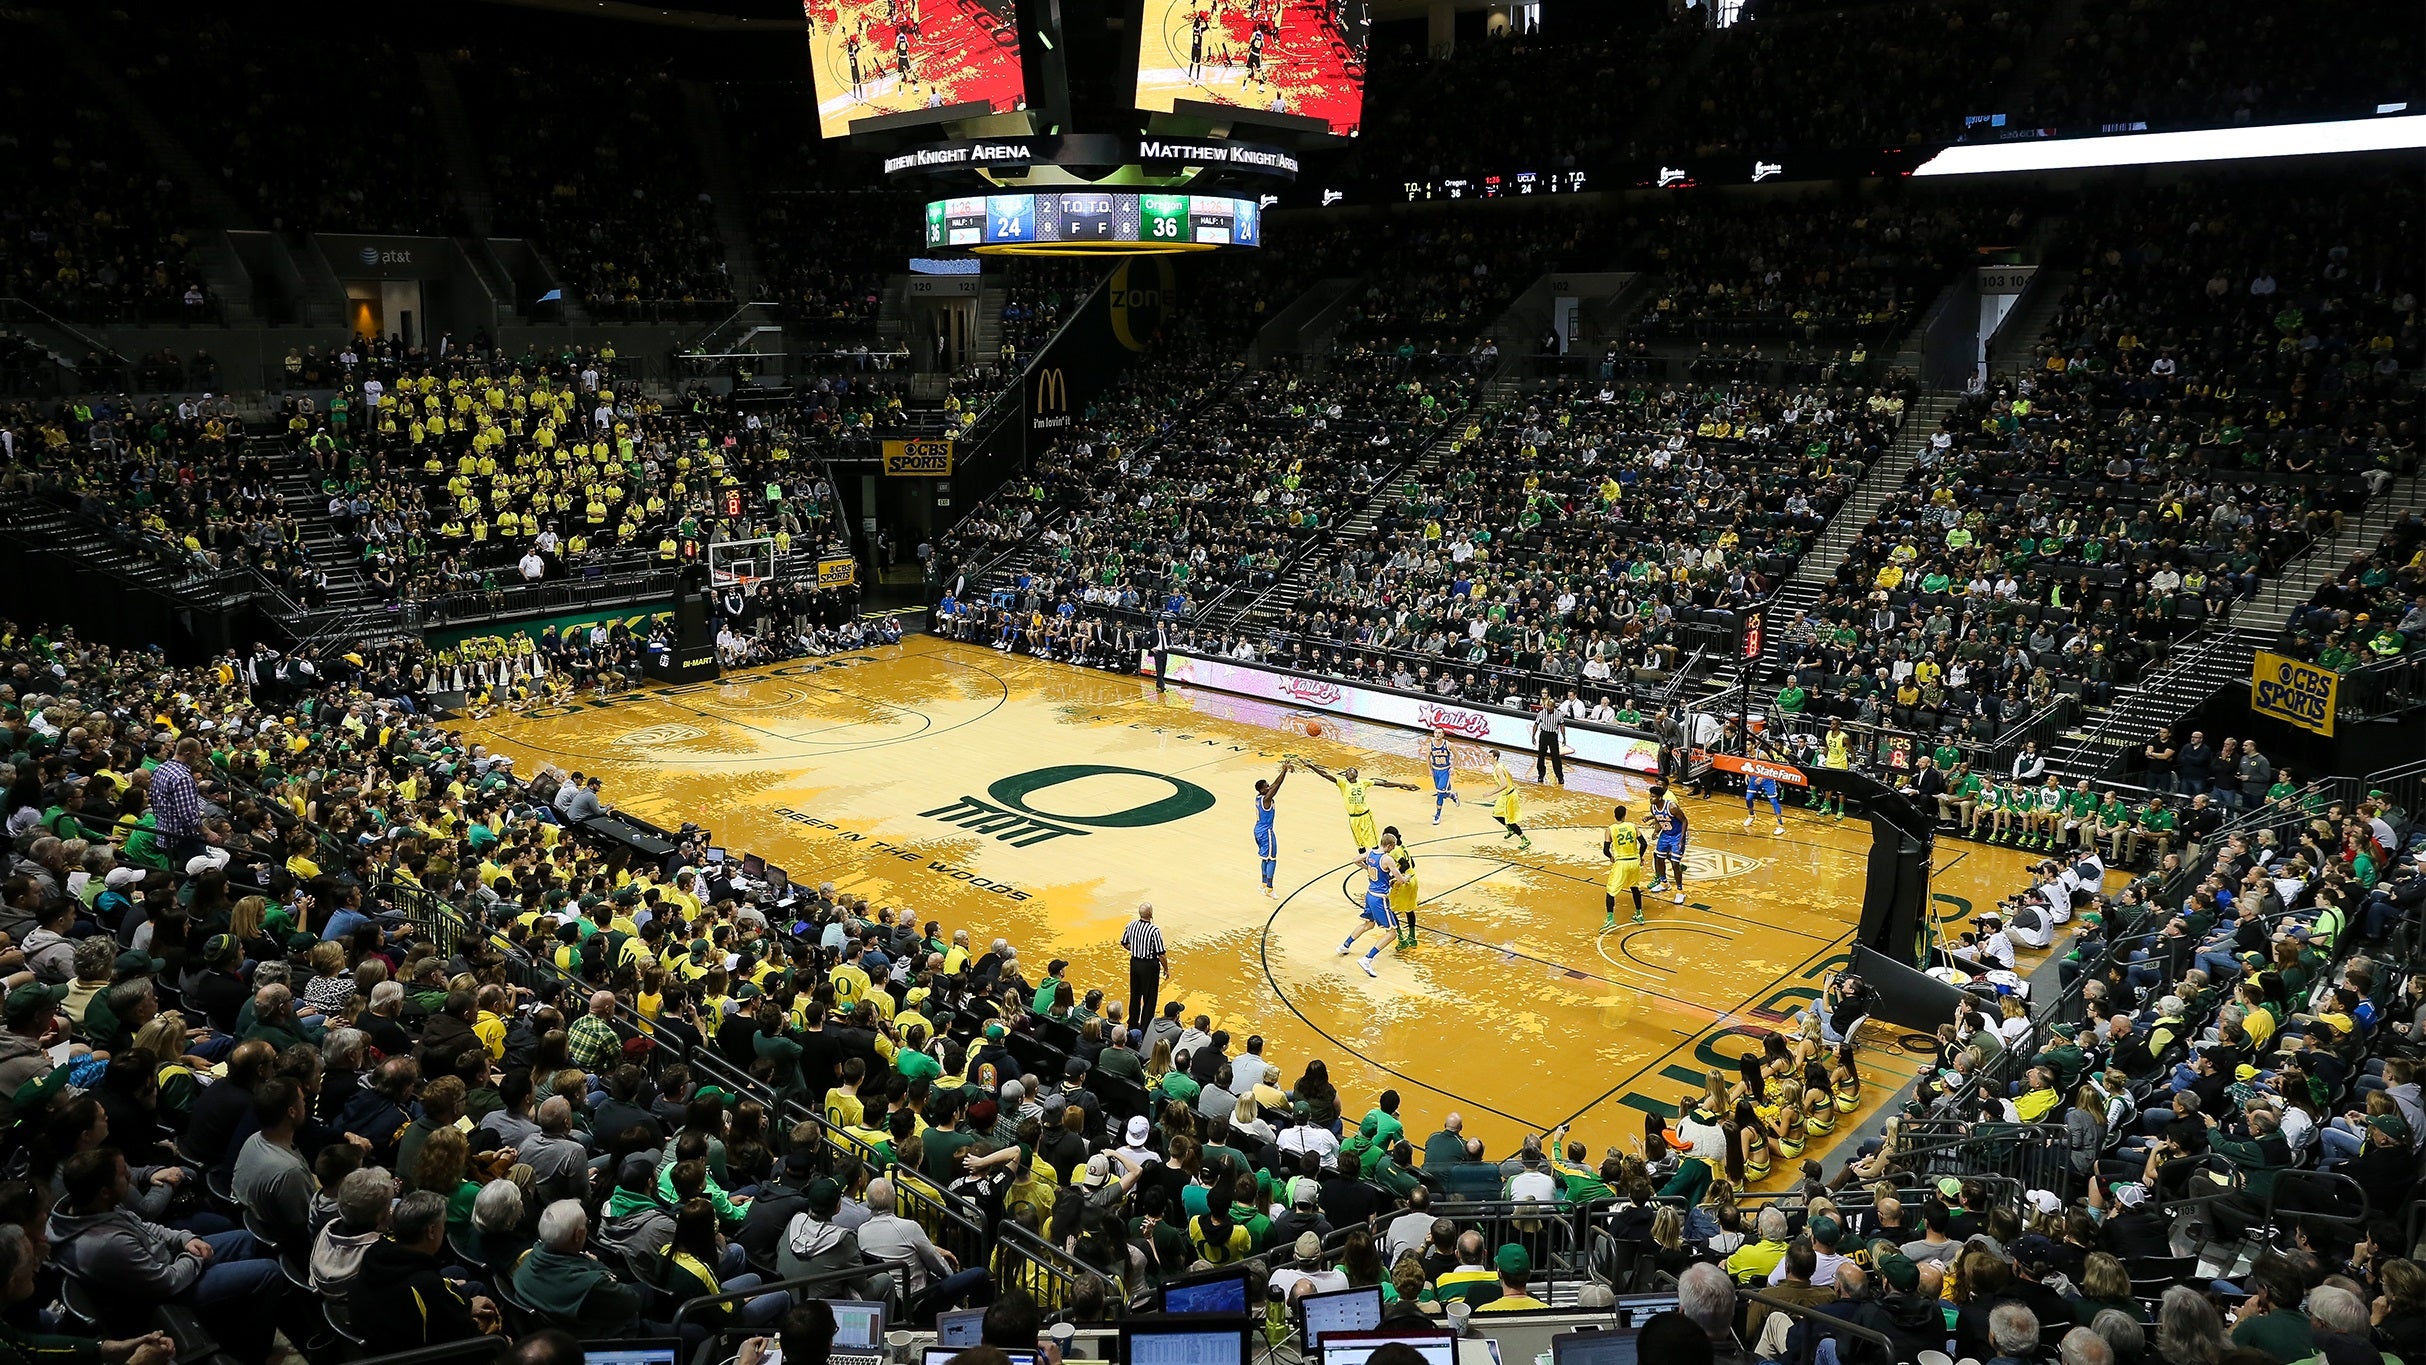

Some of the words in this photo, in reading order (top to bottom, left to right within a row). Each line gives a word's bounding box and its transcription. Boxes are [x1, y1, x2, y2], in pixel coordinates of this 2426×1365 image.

[917, 149, 968, 165] KNIGHT
[971, 145, 1030, 160] ARENA
[1140, 142, 1227, 160] MATTHEW
[1230, 147, 1276, 167] KNIGHT
[1517, 175, 1536, 183] UCLA
[1451, 189, 1461, 198] 36
[1521, 184, 1531, 194] 24
[1043, 203, 1051, 213] 2
[1062, 201, 1086, 213] T.O.
[1087, 201, 1112, 213] T.O.
[1122, 203, 1130, 213] 4
[1145, 200, 1183, 210] Oregon
[997, 218, 1022, 237] 24
[1044, 223, 1051, 233] 8
[1071, 223, 1080, 233] F
[1098, 223, 1107, 233] F
[1122, 223, 1131, 233] 8
[1153, 217, 1178, 237] 36
[1240, 222, 1252, 241] 24
[382, 250, 411, 263] at&t
[913, 282, 931, 291] 120
[959, 281, 976, 291] 121
[1983, 276, 2005, 287] 103
[2010, 276, 2030, 287] 10
[1034, 418, 1044, 428] i'm
[1045, 416, 1064, 428] lovin'
[918, 443, 948, 456] CBS
[889, 456, 947, 473] SPORTS
[729, 500, 738, 515] 8
[835, 564, 852, 572] CBS
[820, 571, 851, 583] SPORTS
[1750, 630, 1758, 655] 8
[683, 656, 714, 669] BI-MART
[1290, 676, 1322, 694] Carl's
[2294, 667, 2333, 698] CBS
[2256, 680, 2328, 720] SPORTS
[1431, 706, 1467, 726] Carl's
[1889, 738, 1911, 751] 1:25
[1894, 751, 1904, 766] 8
[1617, 831, 1634, 846] 24
[773, 807, 840, 831] DEEP
[838, 830, 868, 843] IN
[869, 840, 923, 862] THE
[928, 861, 1033, 901] WOODS
